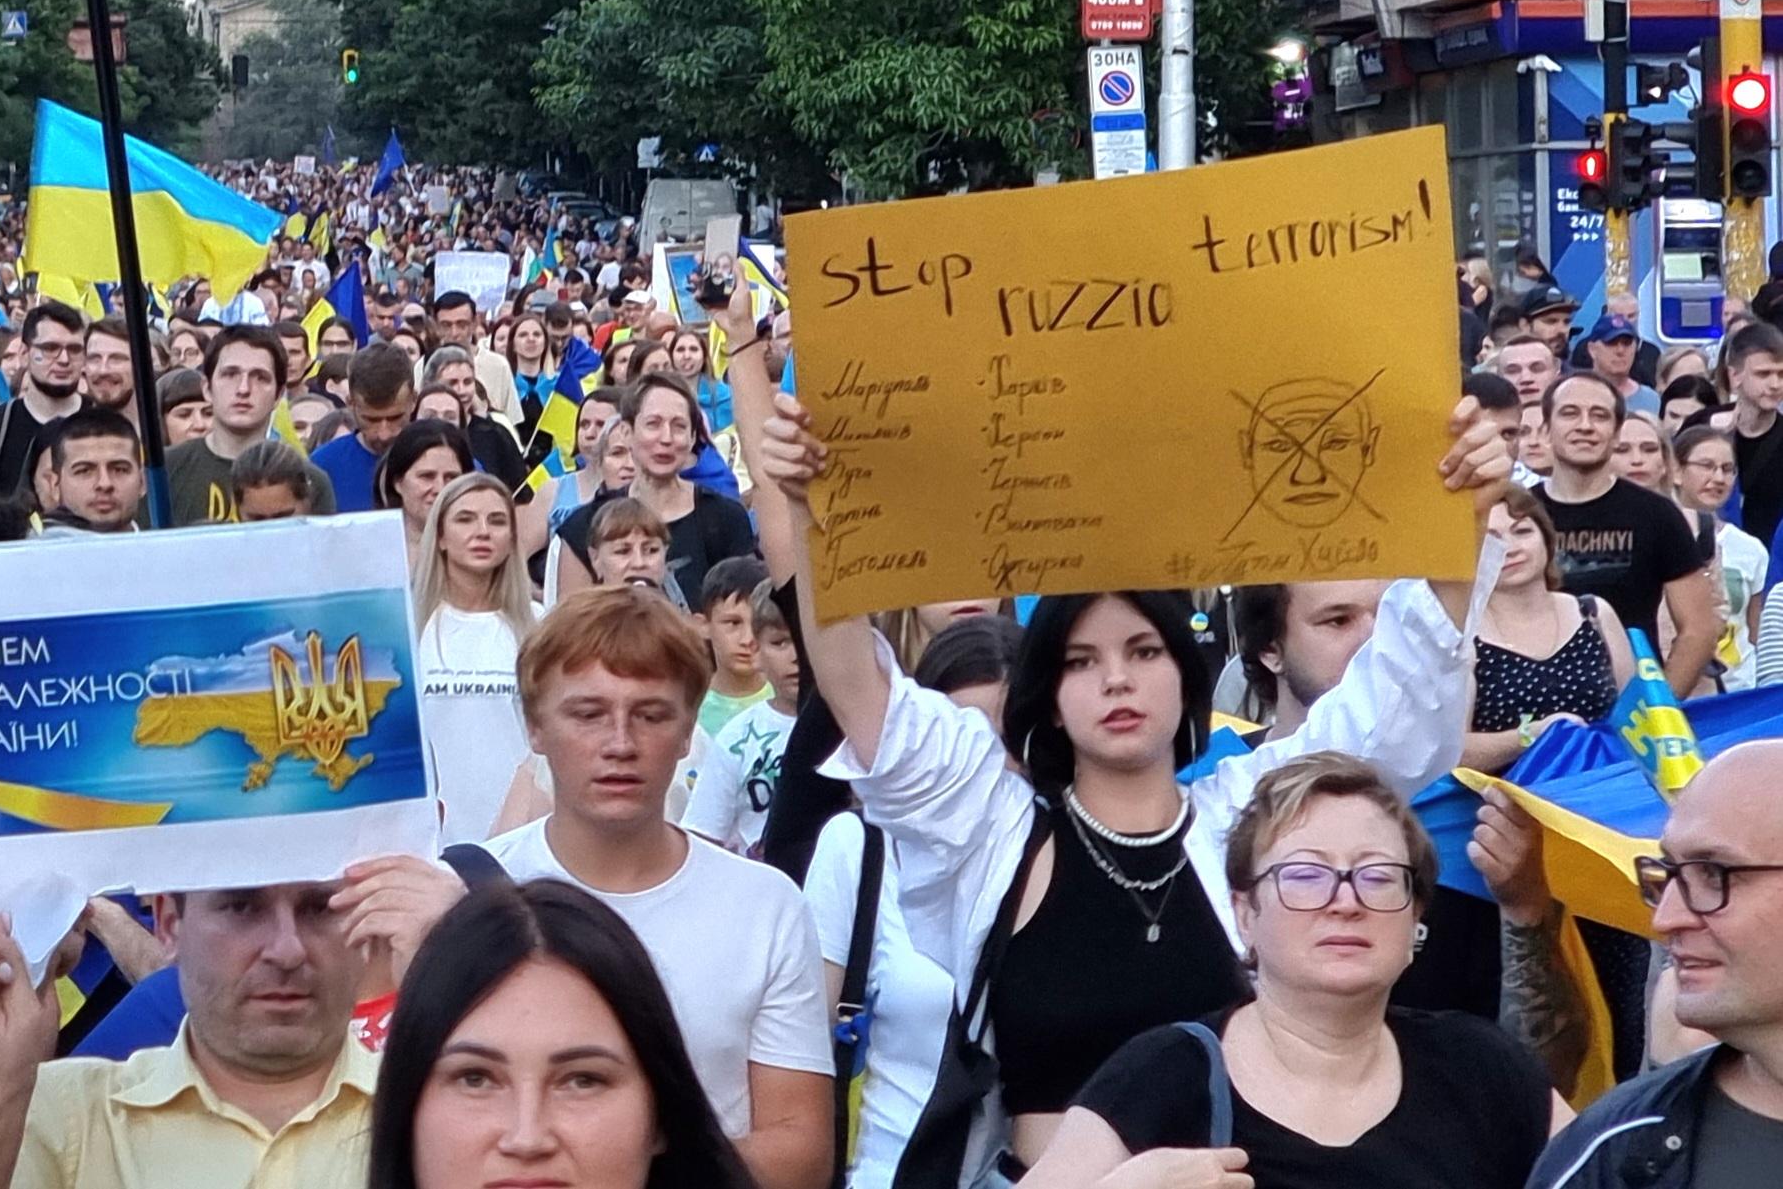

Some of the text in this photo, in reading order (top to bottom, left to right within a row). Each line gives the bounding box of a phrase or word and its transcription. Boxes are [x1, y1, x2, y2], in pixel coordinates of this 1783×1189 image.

[1094, 52, 1136, 66] ЗОНА
[1570, 215, 1605, 228] 24/7
[820, 236, 973, 317] stop
[1191, 178, 1431, 273] terrorism!
[452, 682, 519, 695] UKRAINI
